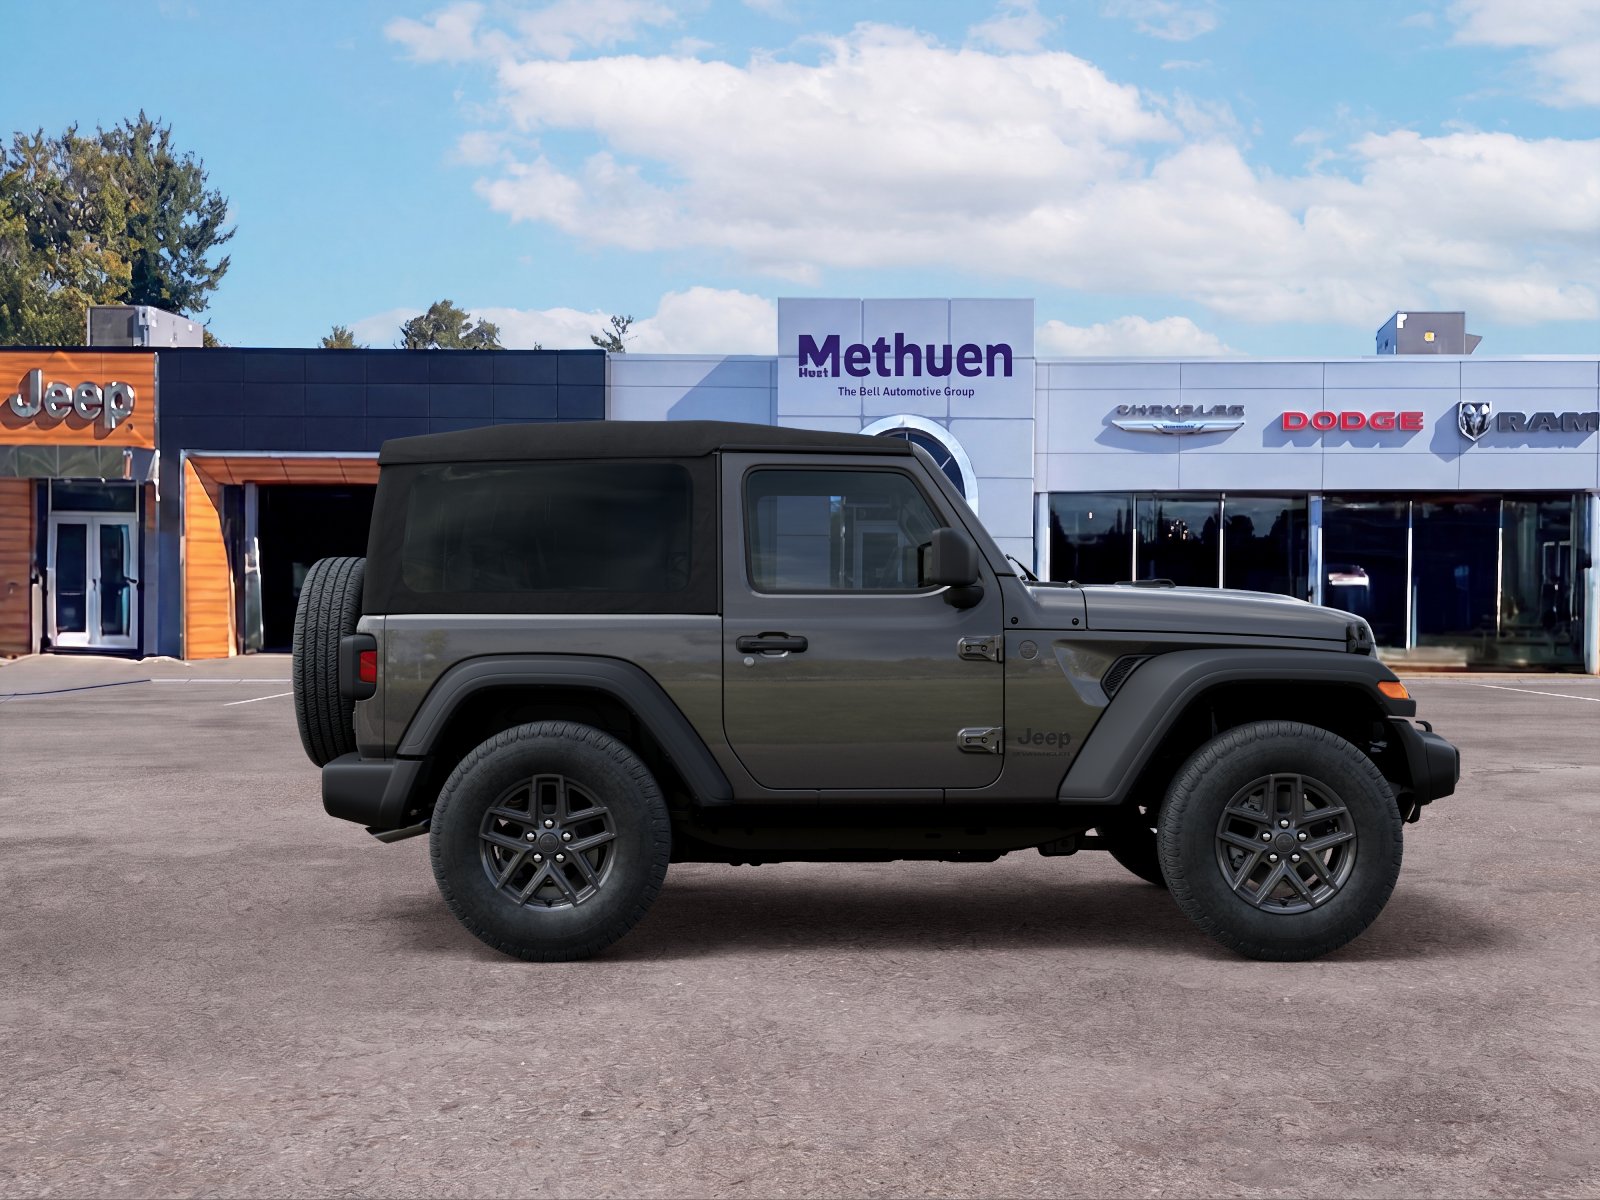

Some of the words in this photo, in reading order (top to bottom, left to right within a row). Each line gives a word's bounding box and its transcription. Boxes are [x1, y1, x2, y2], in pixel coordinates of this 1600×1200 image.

[798, 333, 1013, 378] Methuen
[9, 368, 135, 429] Jeep
[838, 386, 857, 396] The
[860, 386, 880, 396] Bell
[883, 386, 941, 396] Automotive
[944, 386, 975, 398] Group
[1282, 411, 1424, 431] DODGE
[1498, 411, 1599, 432] RAM
[1018, 727, 1071, 748] Jeep
